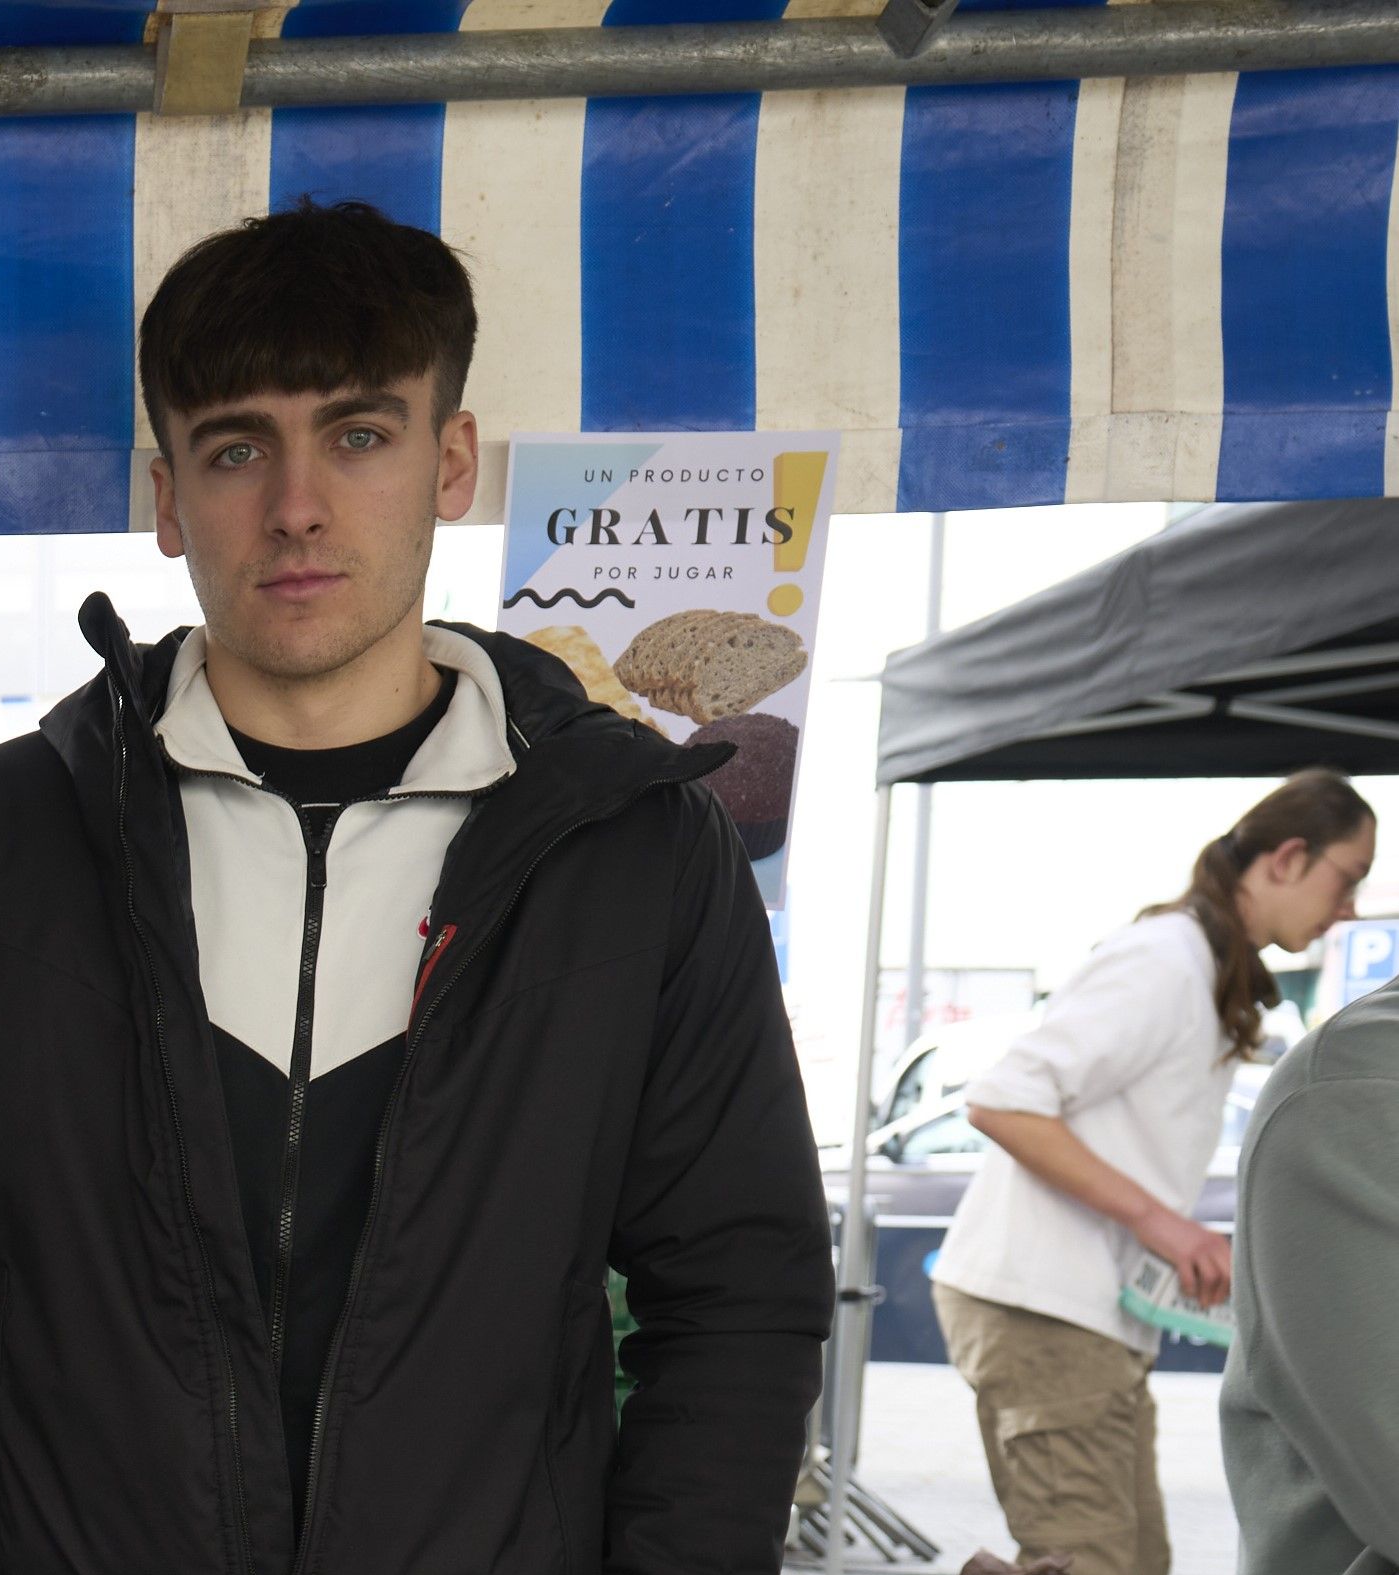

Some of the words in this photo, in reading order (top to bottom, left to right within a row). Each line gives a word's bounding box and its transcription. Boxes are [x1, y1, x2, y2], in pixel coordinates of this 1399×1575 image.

[583, 468, 614, 483] UN
[629, 467, 766, 483] PRODUCTO
[546, 506, 796, 547] GRATIS
[592, 566, 638, 580] POR
[653, 565, 736, 580] JUGAR
[1350, 930, 1393, 978] P
